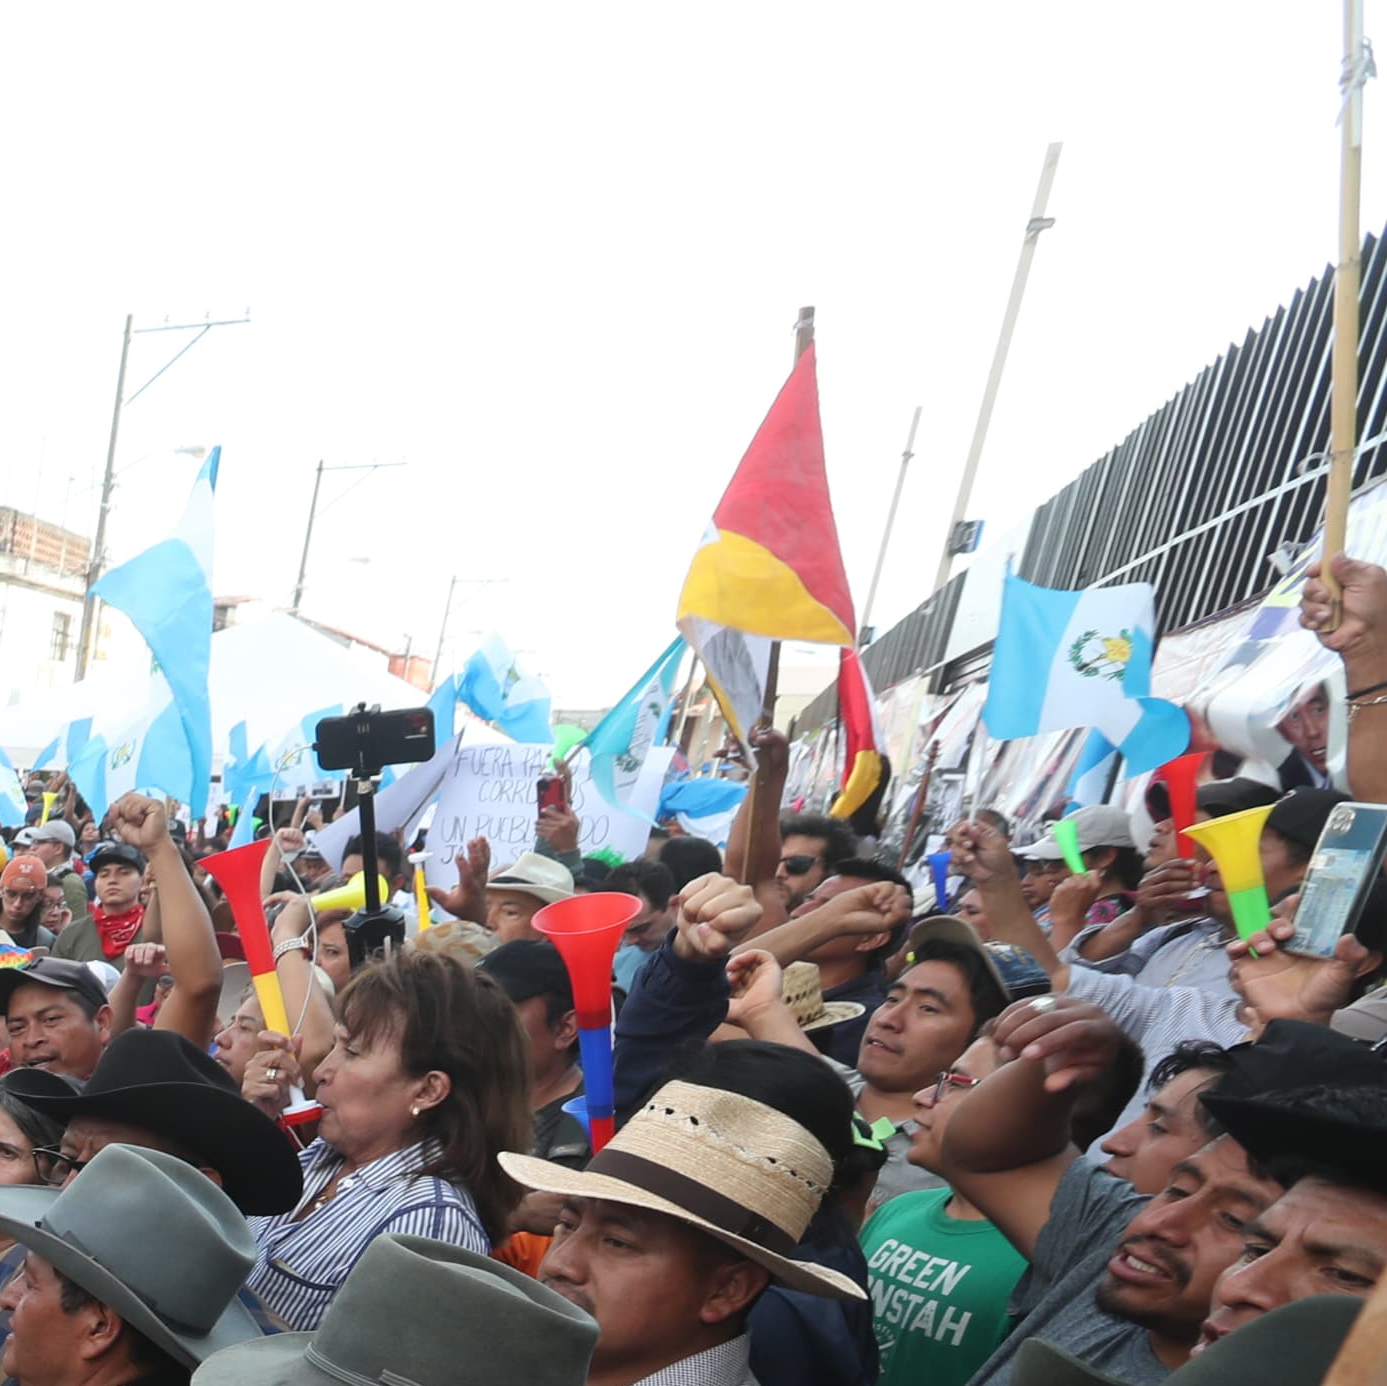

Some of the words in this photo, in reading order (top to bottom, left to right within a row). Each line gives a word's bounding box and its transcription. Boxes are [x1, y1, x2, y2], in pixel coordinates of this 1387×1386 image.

[453, 747, 513, 777] FUERA
[440, 814, 469, 843] UN
[474, 815, 537, 845] PUEBL
[867, 1238, 973, 1297] GREEN
[867, 1274, 973, 1346] NSTAH
